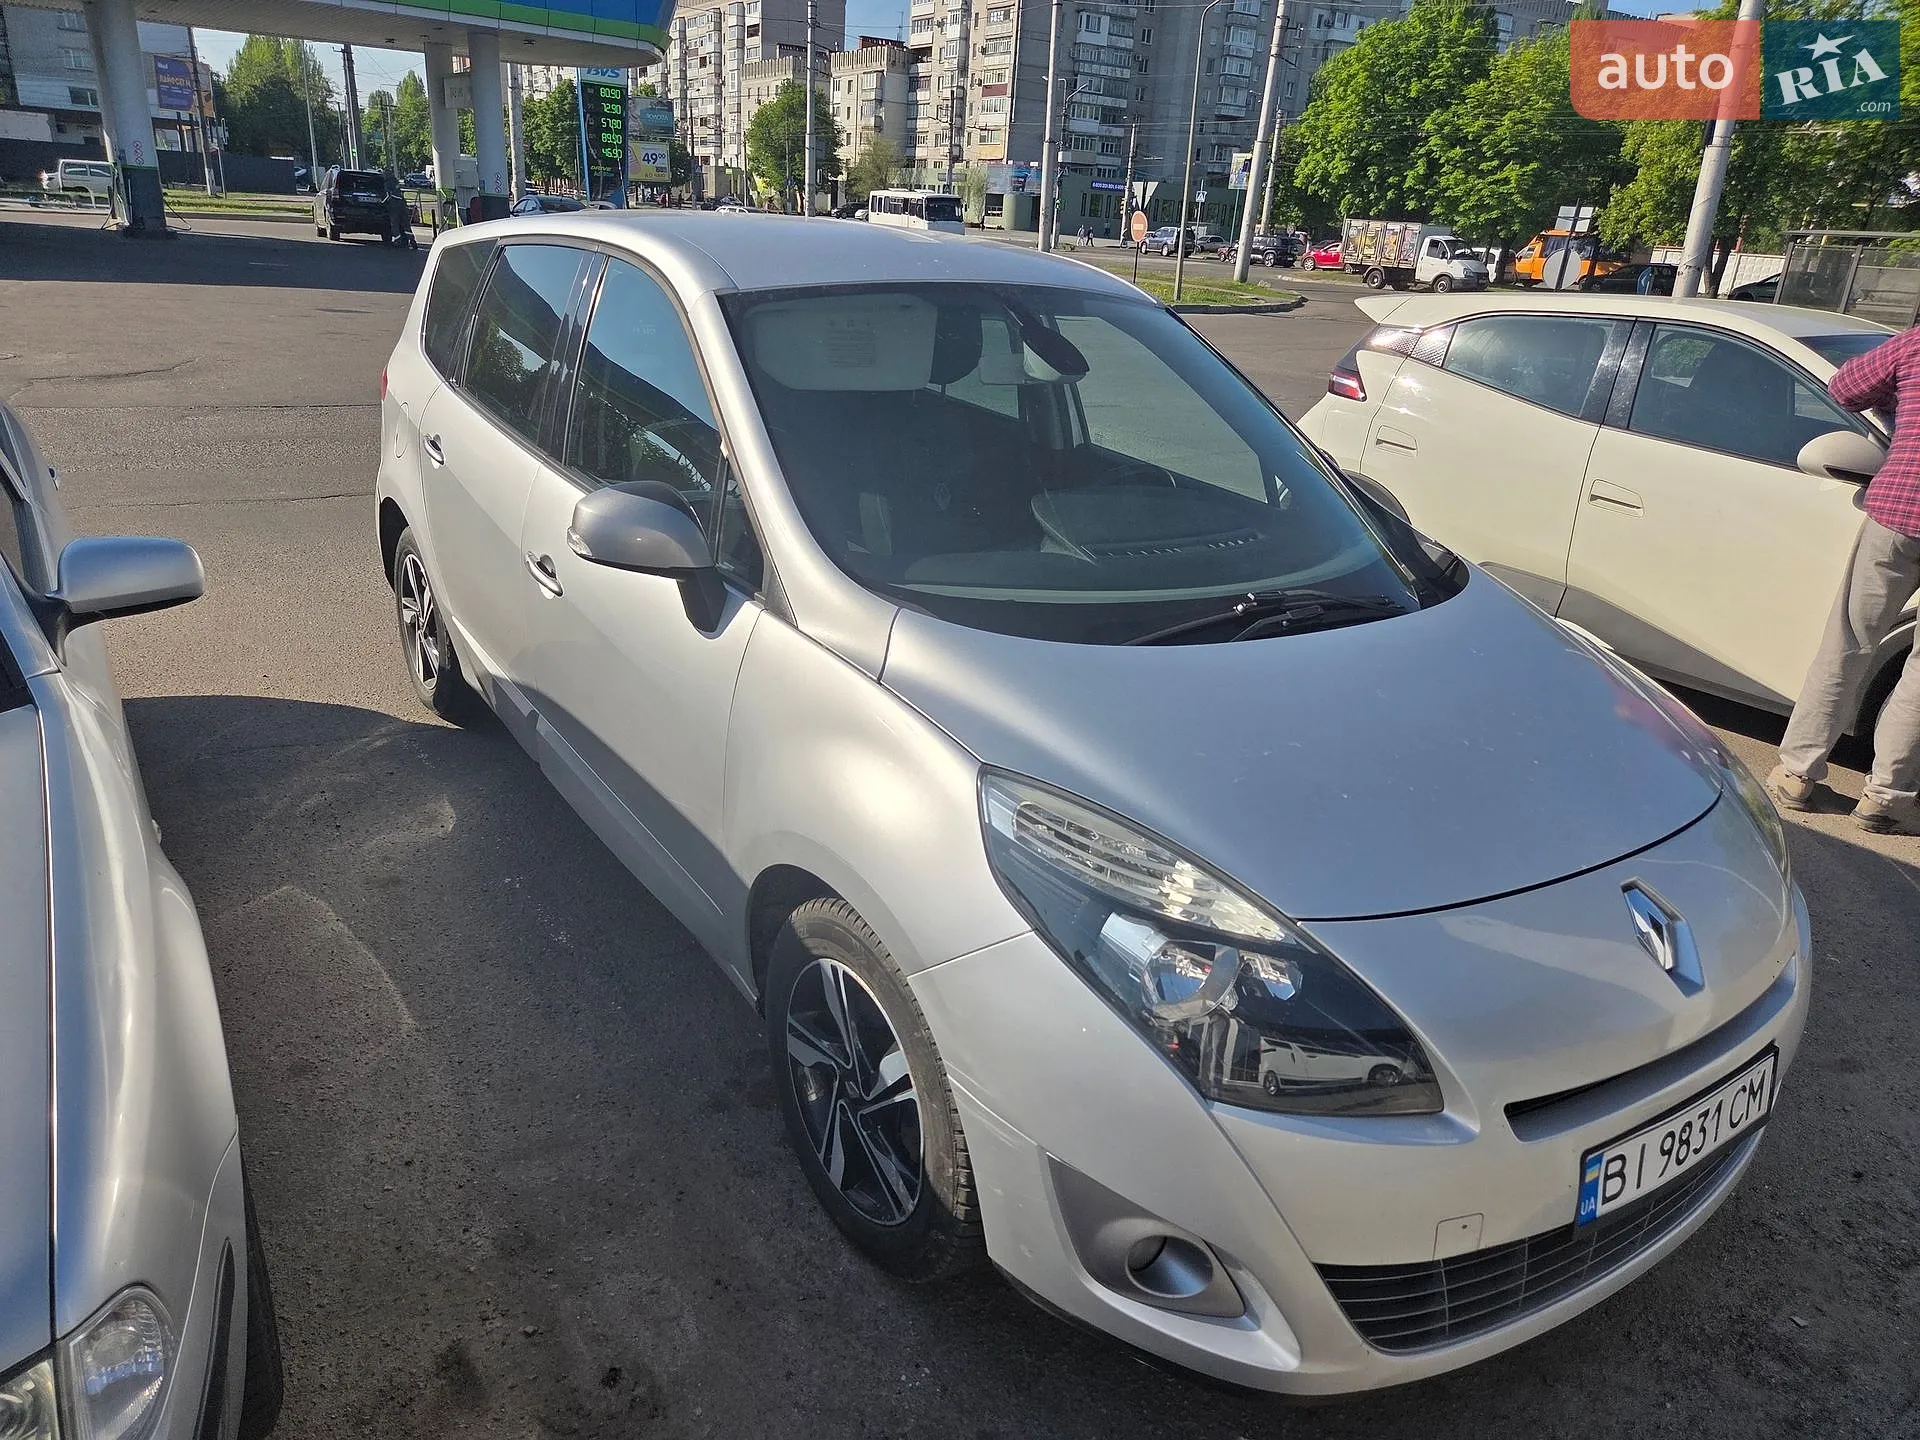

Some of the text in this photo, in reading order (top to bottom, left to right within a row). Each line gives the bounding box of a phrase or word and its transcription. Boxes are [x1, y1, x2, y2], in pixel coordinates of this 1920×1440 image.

[1602, 1069, 1767, 1206] BI 9831 CM
[1580, 1196, 1596, 1216] UA
